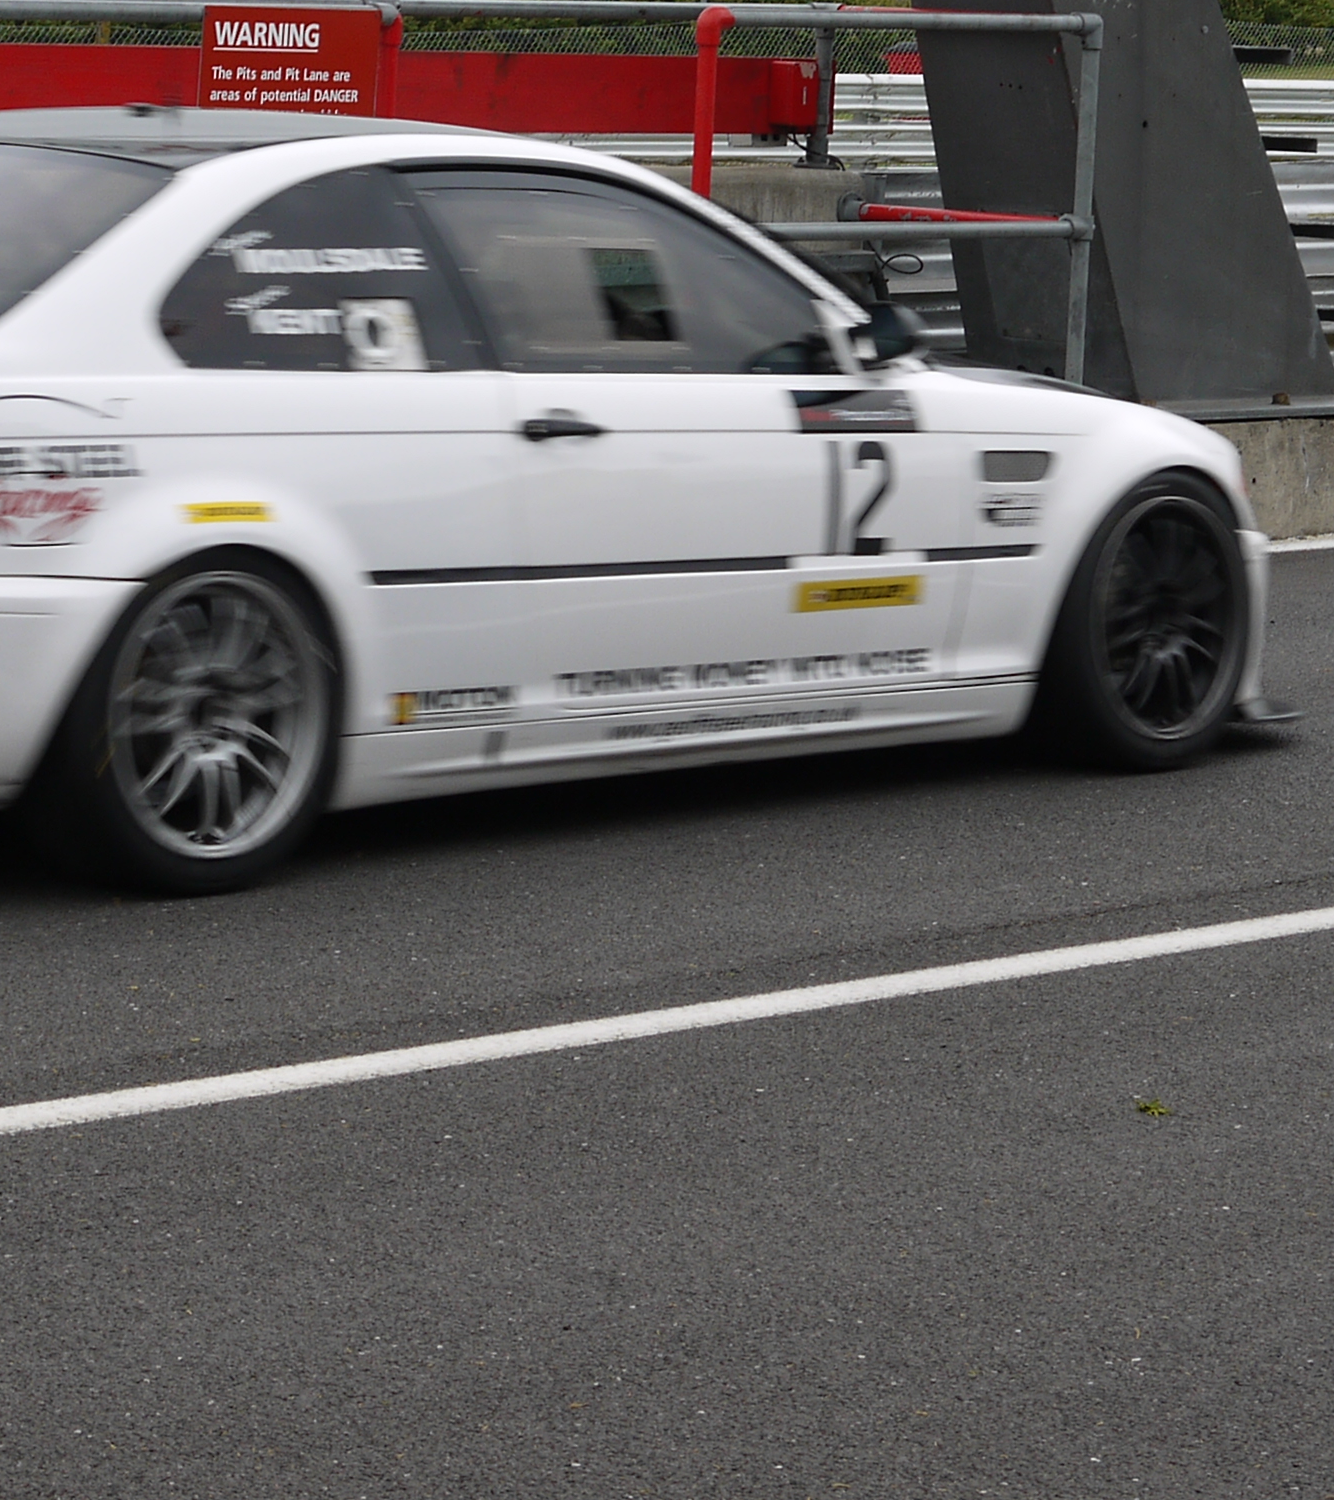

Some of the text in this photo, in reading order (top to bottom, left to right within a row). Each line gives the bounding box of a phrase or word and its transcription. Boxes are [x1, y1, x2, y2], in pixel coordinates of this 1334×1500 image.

[214, 21, 320, 48] WARNING
[212, 66, 351, 83] The Pits and Pit Lane are
[210, 87, 359, 105] areas of potential DANGER
[825, 440, 898, 556] 12
